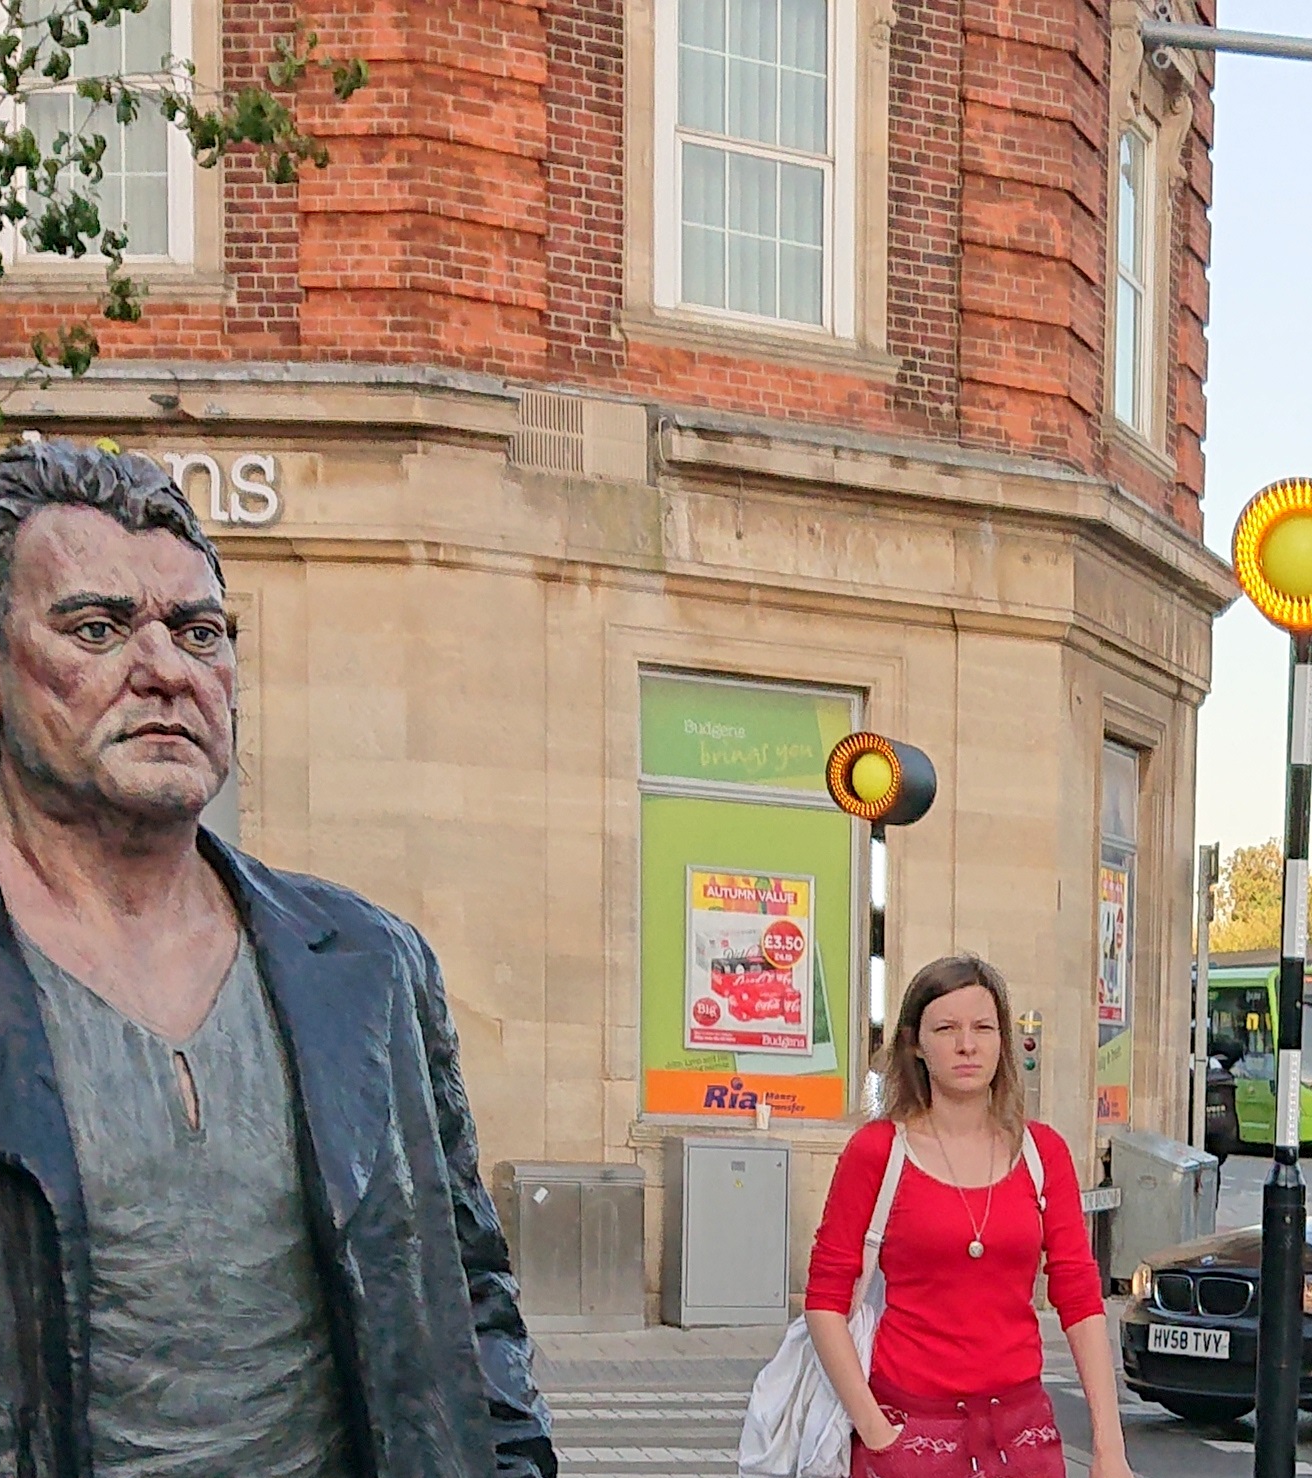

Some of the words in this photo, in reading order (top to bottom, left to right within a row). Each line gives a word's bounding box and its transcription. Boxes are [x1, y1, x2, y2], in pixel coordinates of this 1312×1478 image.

[684, 719, 747, 739] Budgens
[700, 741, 769, 775] brings
[776, 743, 814, 771] you
[706, 885, 756, 901] AUTUMN
[758, 890, 795, 904] VALUE
[764, 933, 804, 952] £3.50
[696, 1004, 717, 1018] Big
[761, 1034, 806, 1048] Budgens
[703, 1077, 759, 1110] Ria
[765, 1092, 797, 1102] Money
[1154, 1328, 1188, 1350] HV58
[1193, 1332, 1222, 1353] TVY
